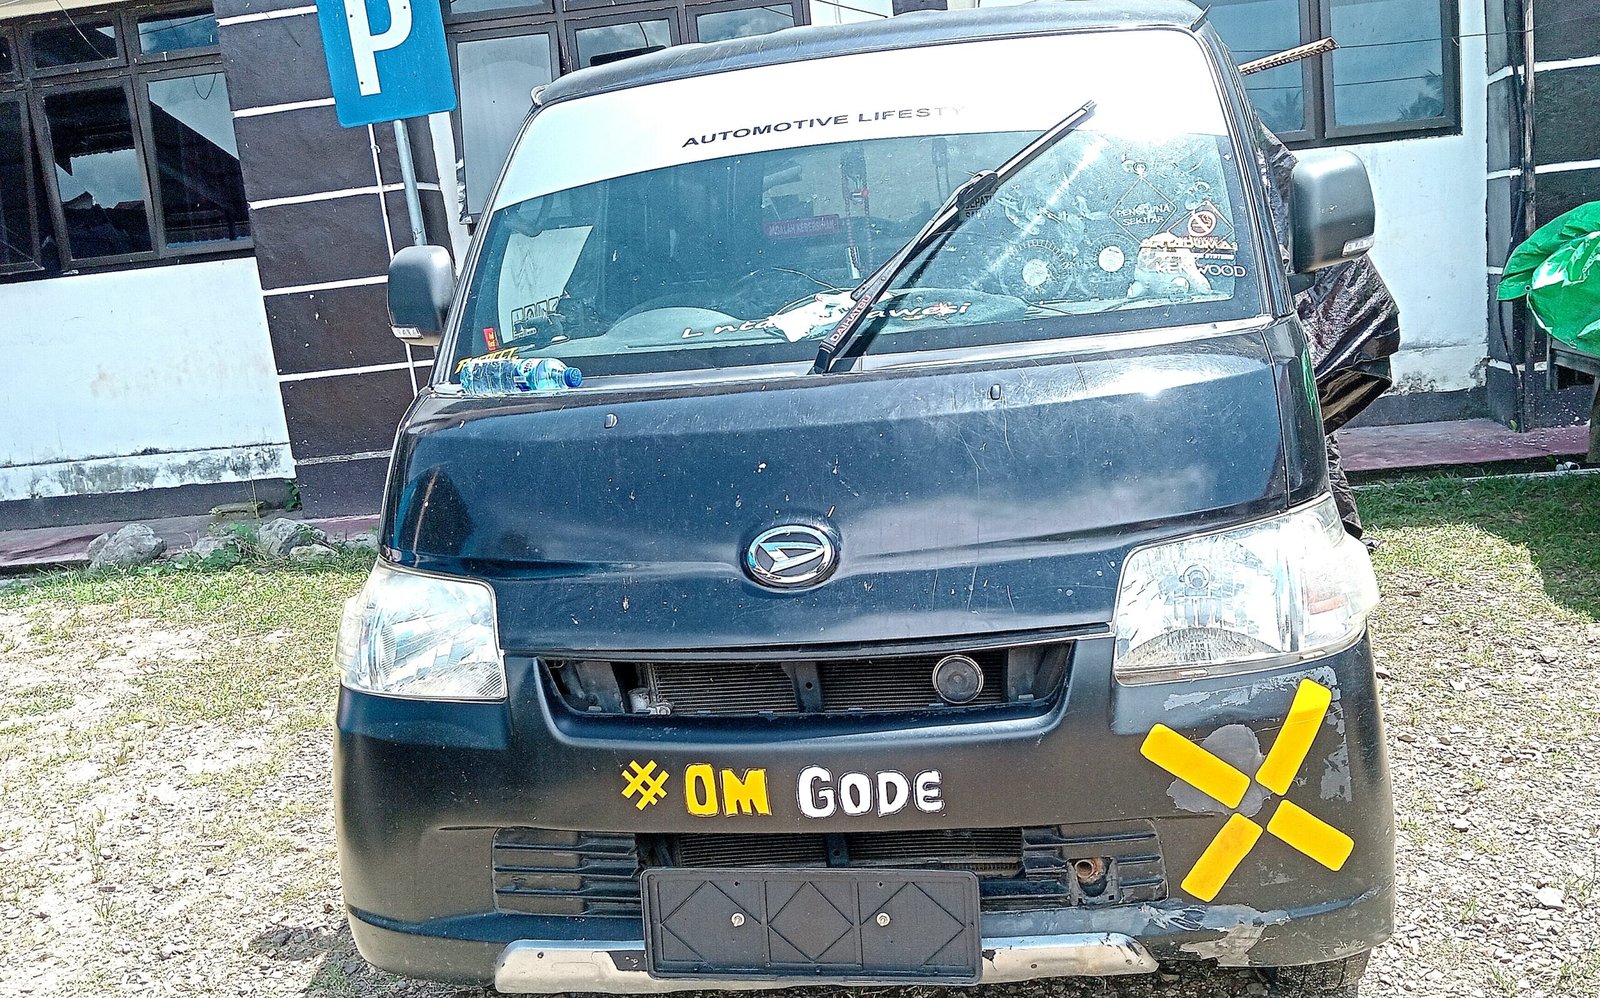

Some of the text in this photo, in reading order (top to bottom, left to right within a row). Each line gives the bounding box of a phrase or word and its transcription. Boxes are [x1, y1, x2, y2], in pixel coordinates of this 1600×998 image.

[343, 0, 412, 96] P
[681, 106, 964, 148] AUTOMOTIVE LIFESTY
[1116, 203, 1171, 217] PENGGUNA
[1123, 216, 1165, 226] SEKITAR
[1155, 262, 1246, 277] KENWOOD
[830, 294, 873, 342] DAIHATSU
[797, 764, 945, 818] GODE
